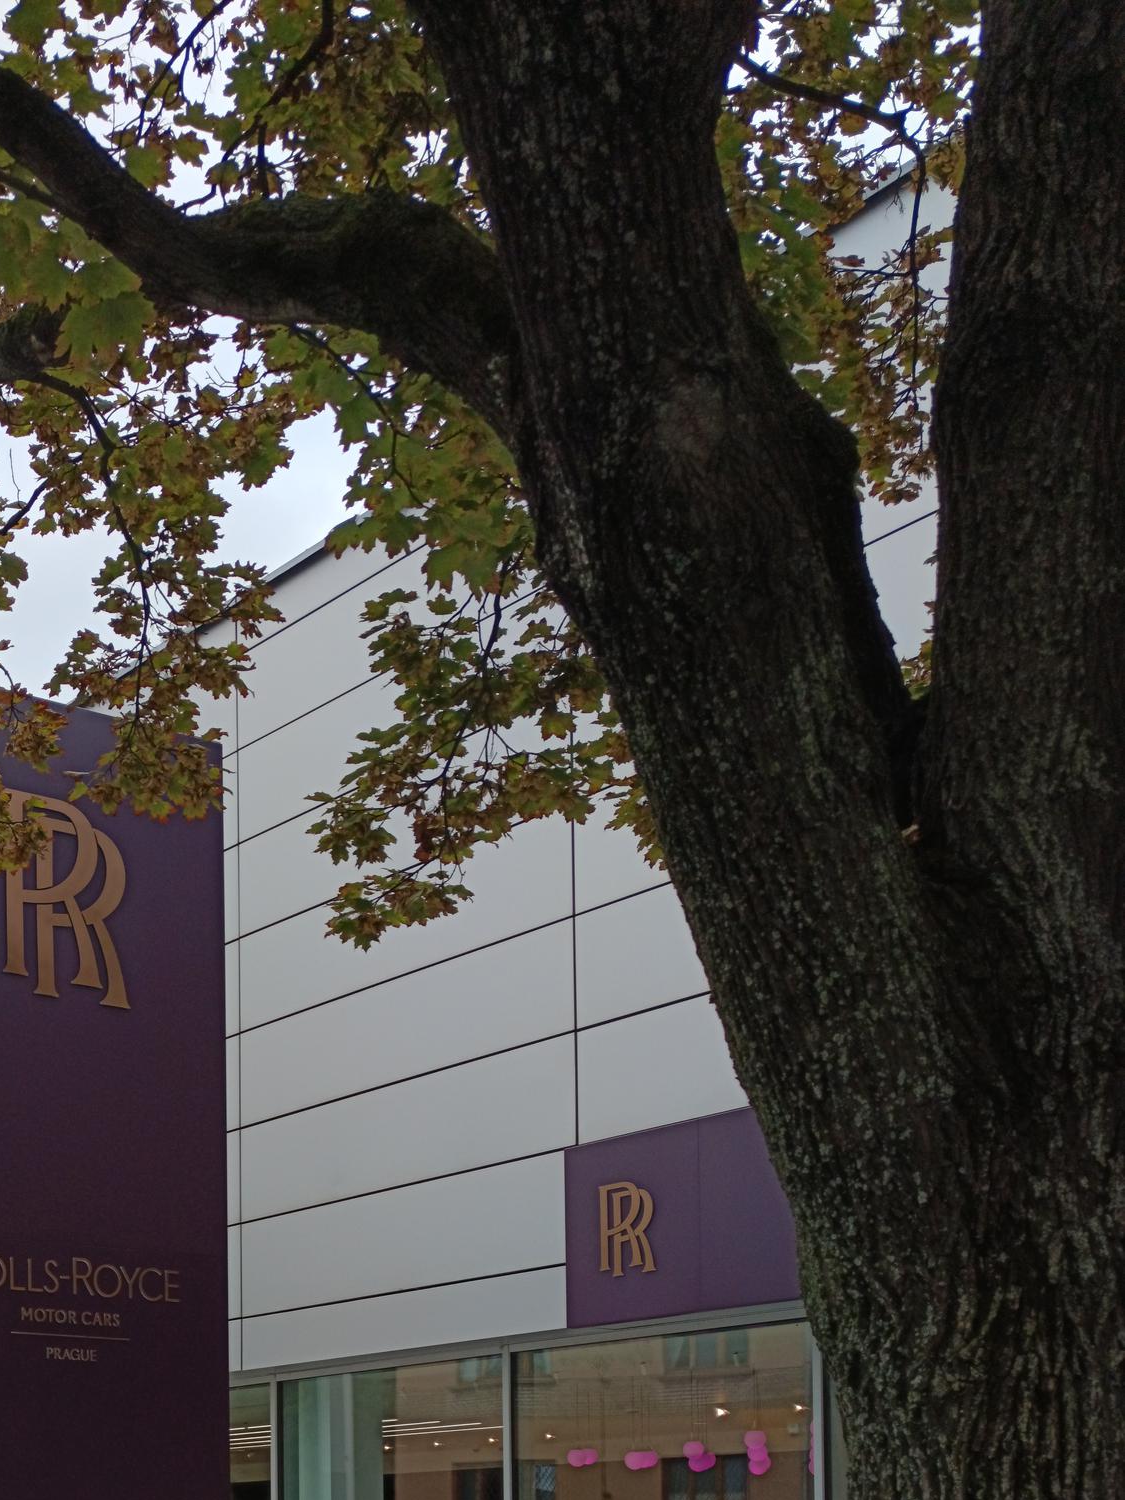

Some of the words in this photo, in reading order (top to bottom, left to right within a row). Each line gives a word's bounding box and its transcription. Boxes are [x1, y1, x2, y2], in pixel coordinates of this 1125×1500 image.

[2, 788, 131, 1009] RR
[598, 1181, 657, 1277] RR
[20, 1306, 77, 1326] MOTOR
[81, 1311, 121, 1328] CARS
[45, 1347, 98, 1362] PRAGUE
